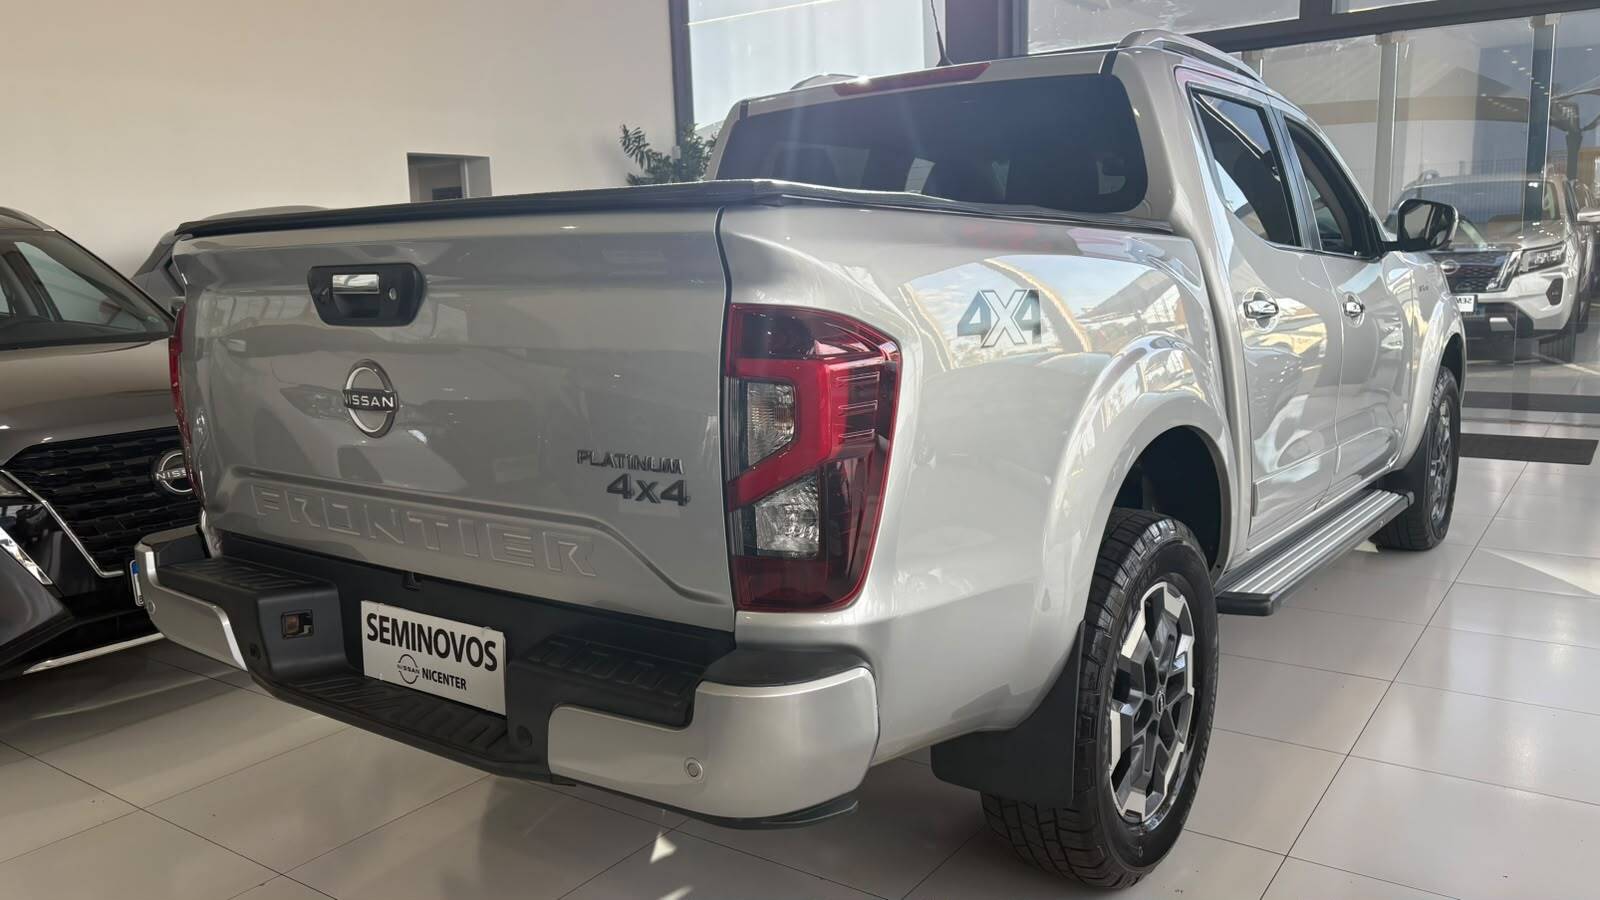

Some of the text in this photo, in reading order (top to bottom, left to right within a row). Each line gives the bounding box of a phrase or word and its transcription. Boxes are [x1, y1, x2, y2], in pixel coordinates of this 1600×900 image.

[957, 289, 1042, 348] 4X4
[343, 393, 394, 408] NISSAN
[156, 469, 187, 480] NISS
[576, 449, 684, 475] PLATINUM
[250, 484, 597, 577] FRONTIER
[366, 612, 498, 672] SEMINOVOS
[421, 667, 467, 691] NICENTER
